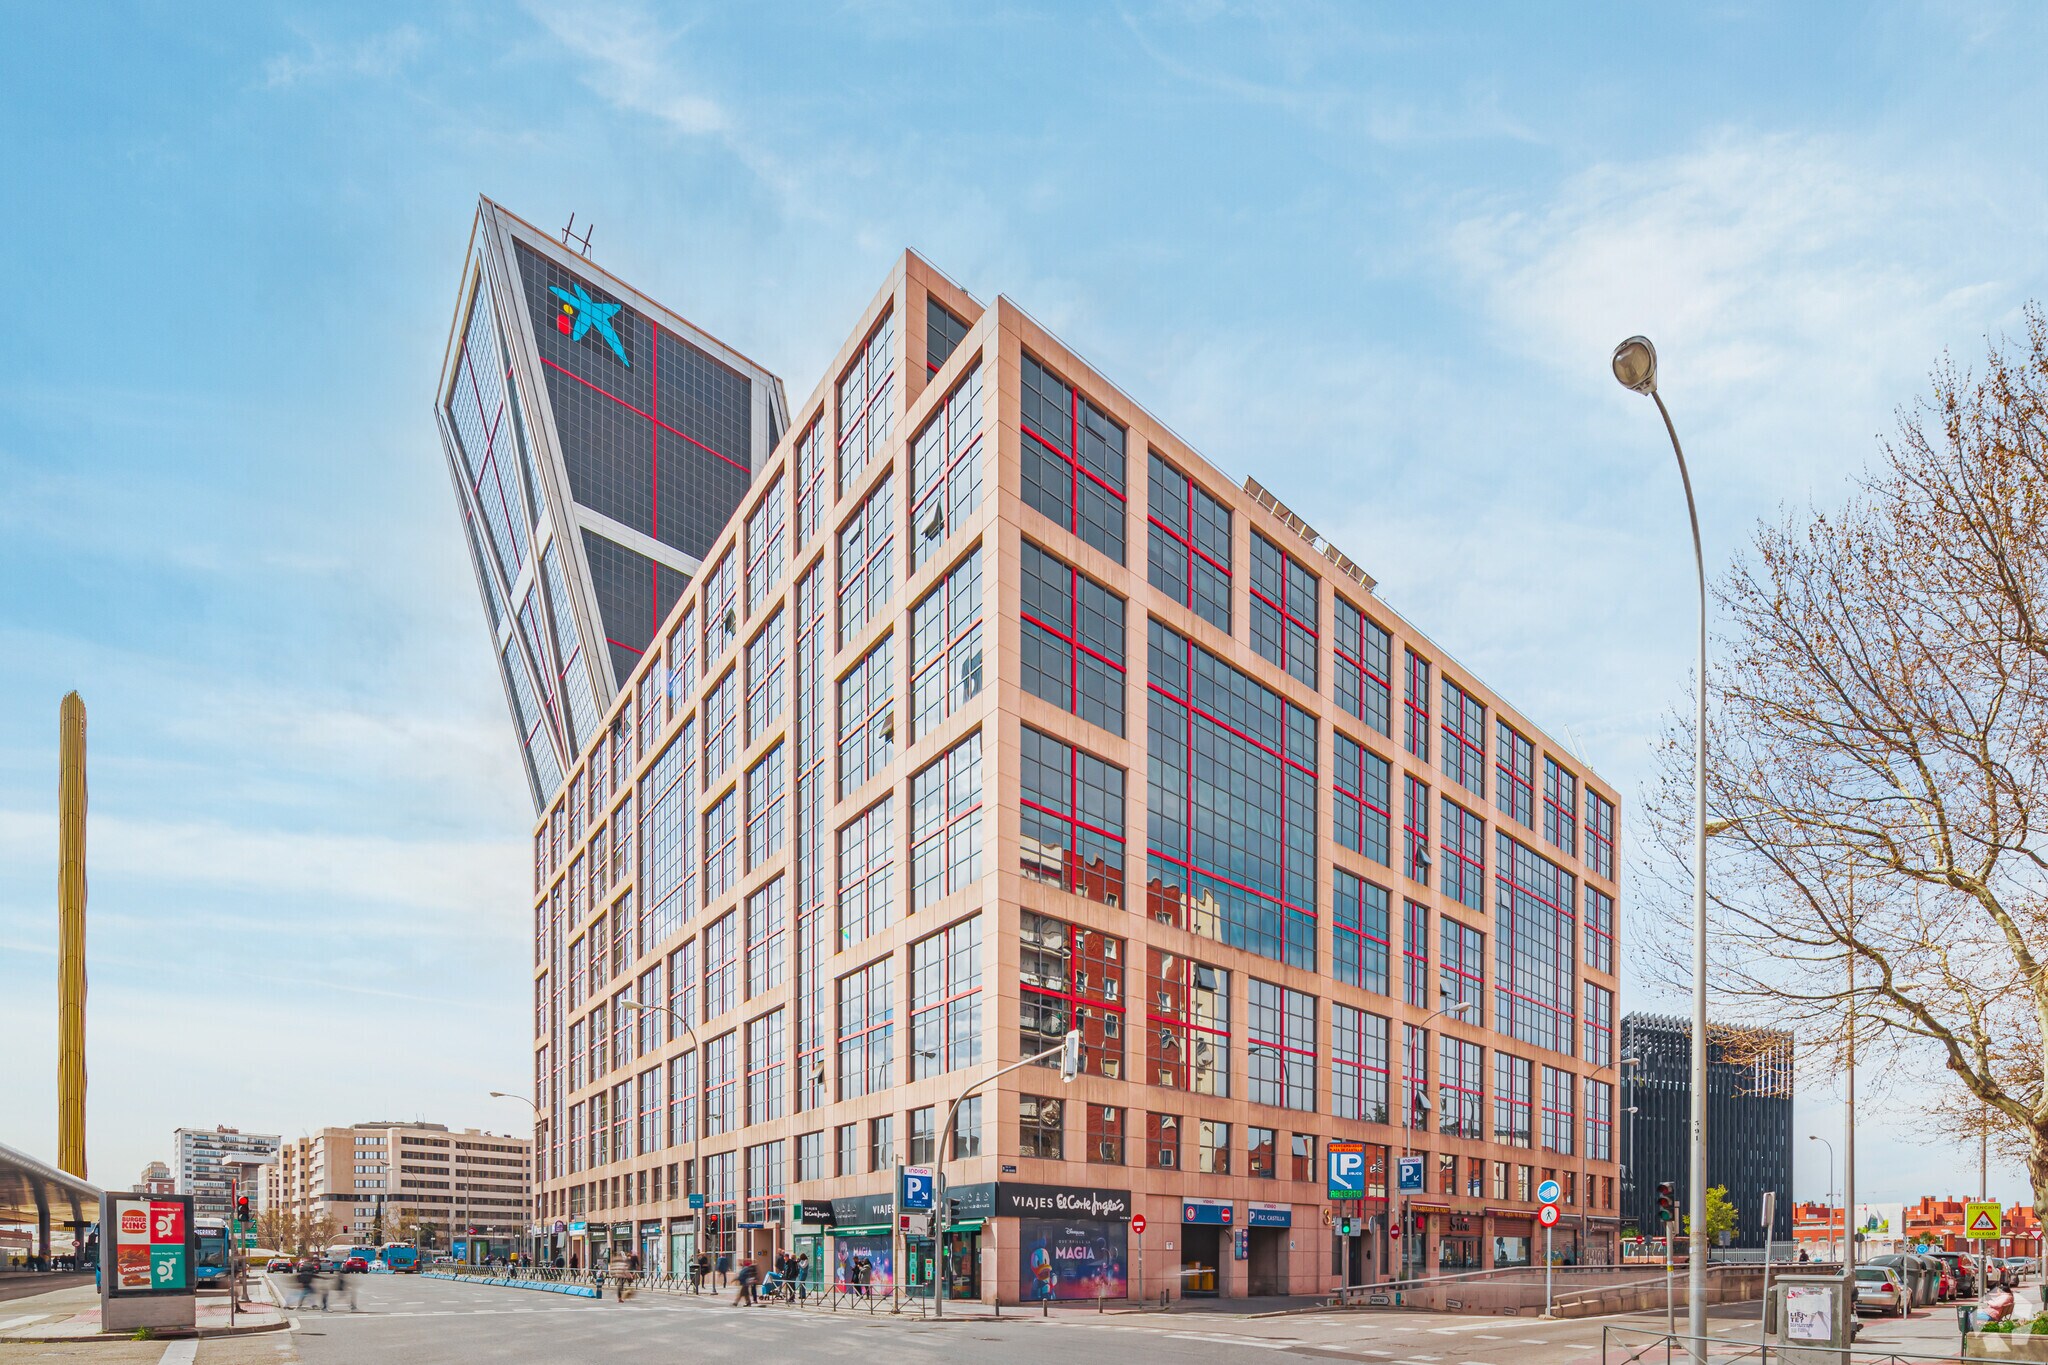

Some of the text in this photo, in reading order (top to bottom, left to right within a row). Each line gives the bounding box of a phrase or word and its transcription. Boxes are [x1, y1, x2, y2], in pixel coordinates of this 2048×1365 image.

[1402, 1166, 1414, 1182] P
[908, 1177, 922, 1199] P
[1330, 1190, 1362, 1198] ABIERTO
[1012, 1192, 1124, 1216] VIAJES El Corte Inglés
[1323, 1209, 1331, 1225] 3
[853, 1247, 872, 1256] MAGIA
[1056, 1247, 1094, 1259] MAGIA
